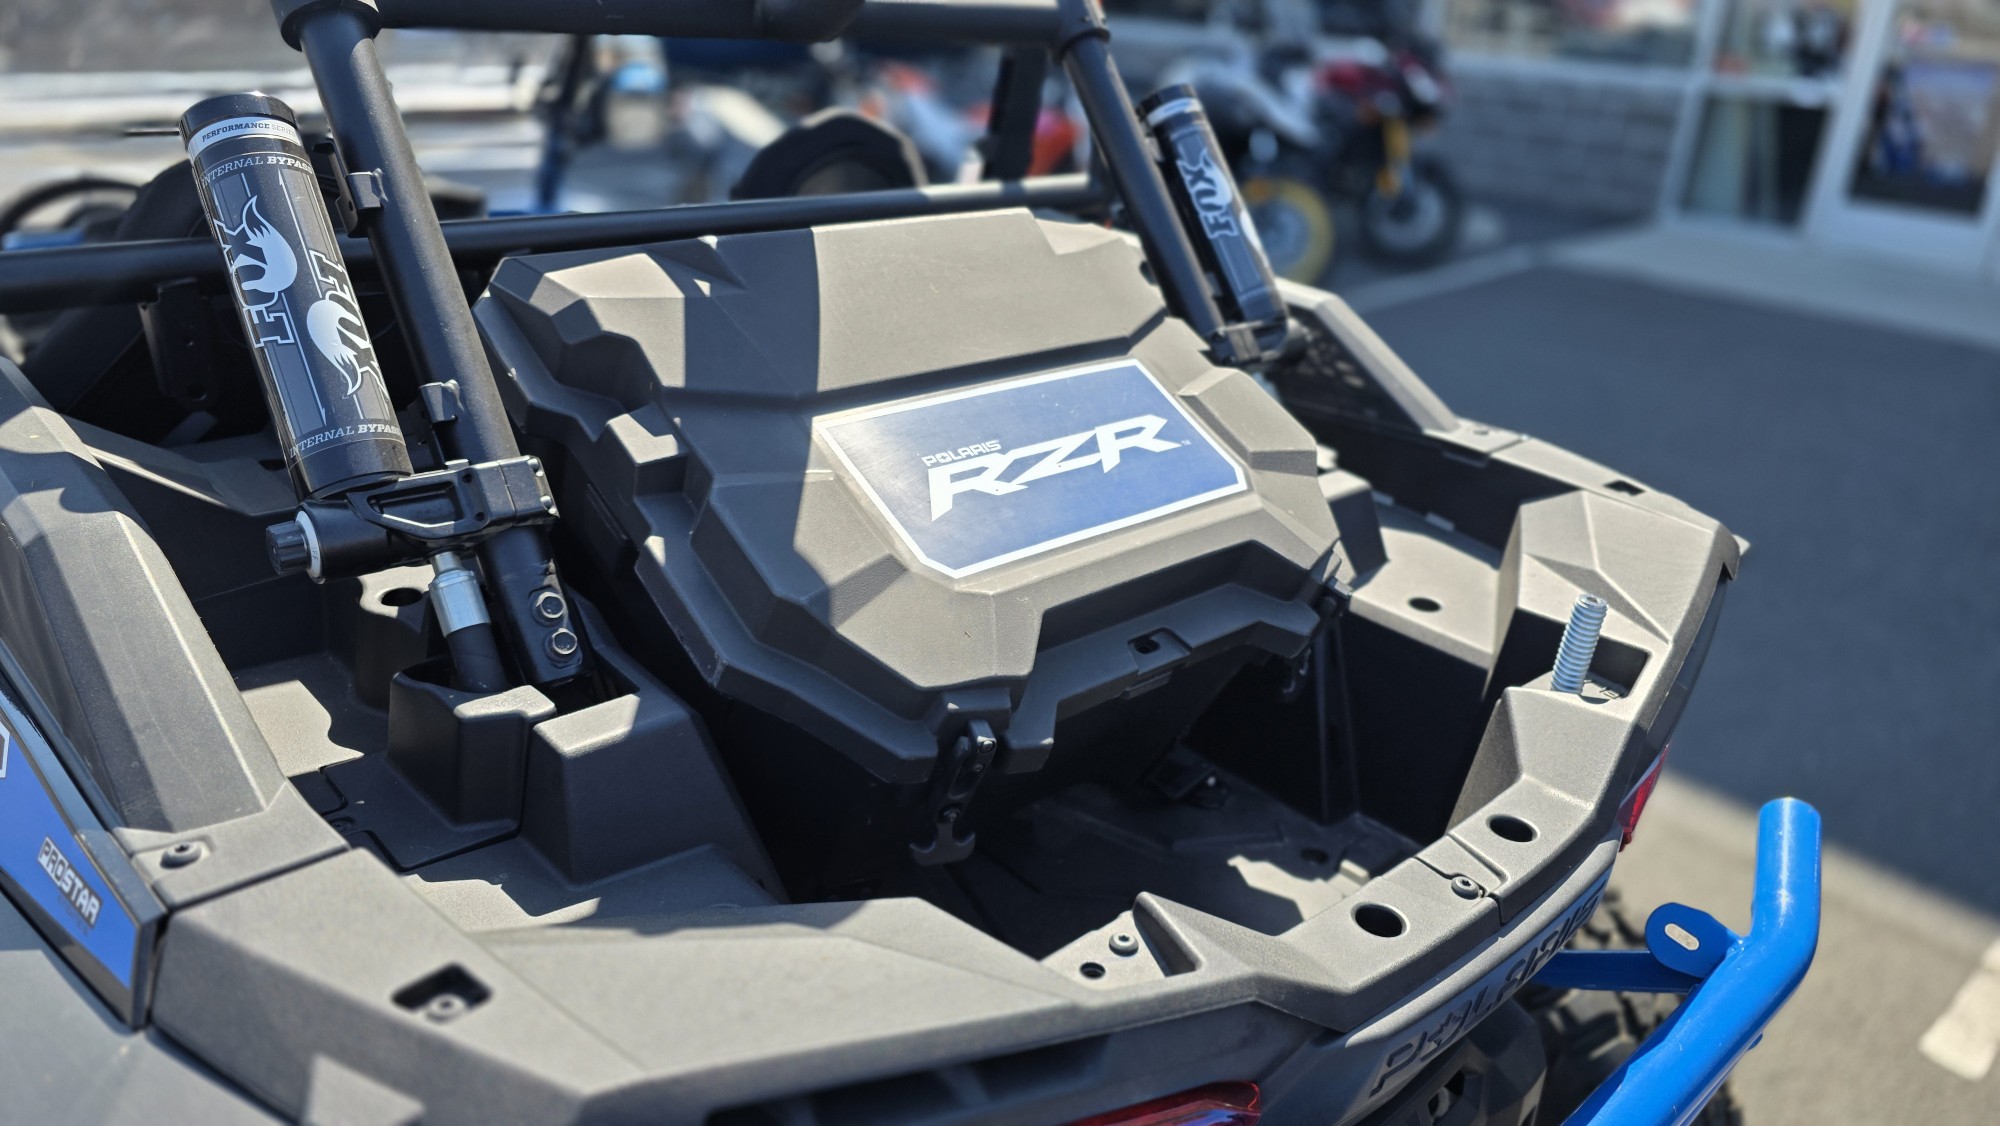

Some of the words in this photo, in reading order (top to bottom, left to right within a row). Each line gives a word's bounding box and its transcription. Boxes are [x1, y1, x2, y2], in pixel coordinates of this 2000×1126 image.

[202, 123, 270, 142] PERFORMANCE
[202, 156, 264, 188] INTERNAL
[1175, 147, 1238, 239] FOX
[213, 195, 298, 349] FOX
[290, 426, 355, 459] INTERNAL
[921, 440, 1002, 467] POLARIS
[927, 414, 1183, 522] RZR
[38, 837, 101, 926] PROSTAR
